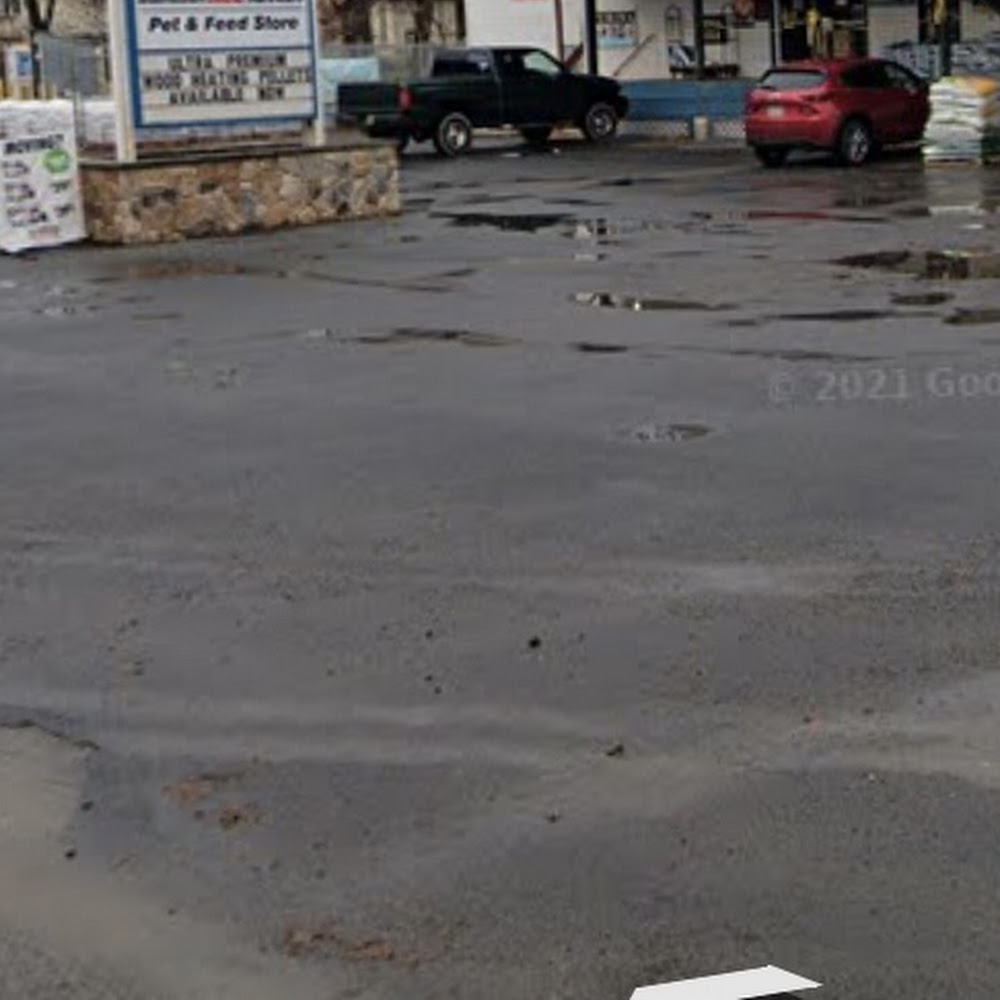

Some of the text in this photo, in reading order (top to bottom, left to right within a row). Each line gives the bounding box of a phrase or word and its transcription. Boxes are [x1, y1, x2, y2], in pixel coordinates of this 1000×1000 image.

[148, 15, 299, 32] Pet & Feed Store
[257, 86, 285, 101] NOW
